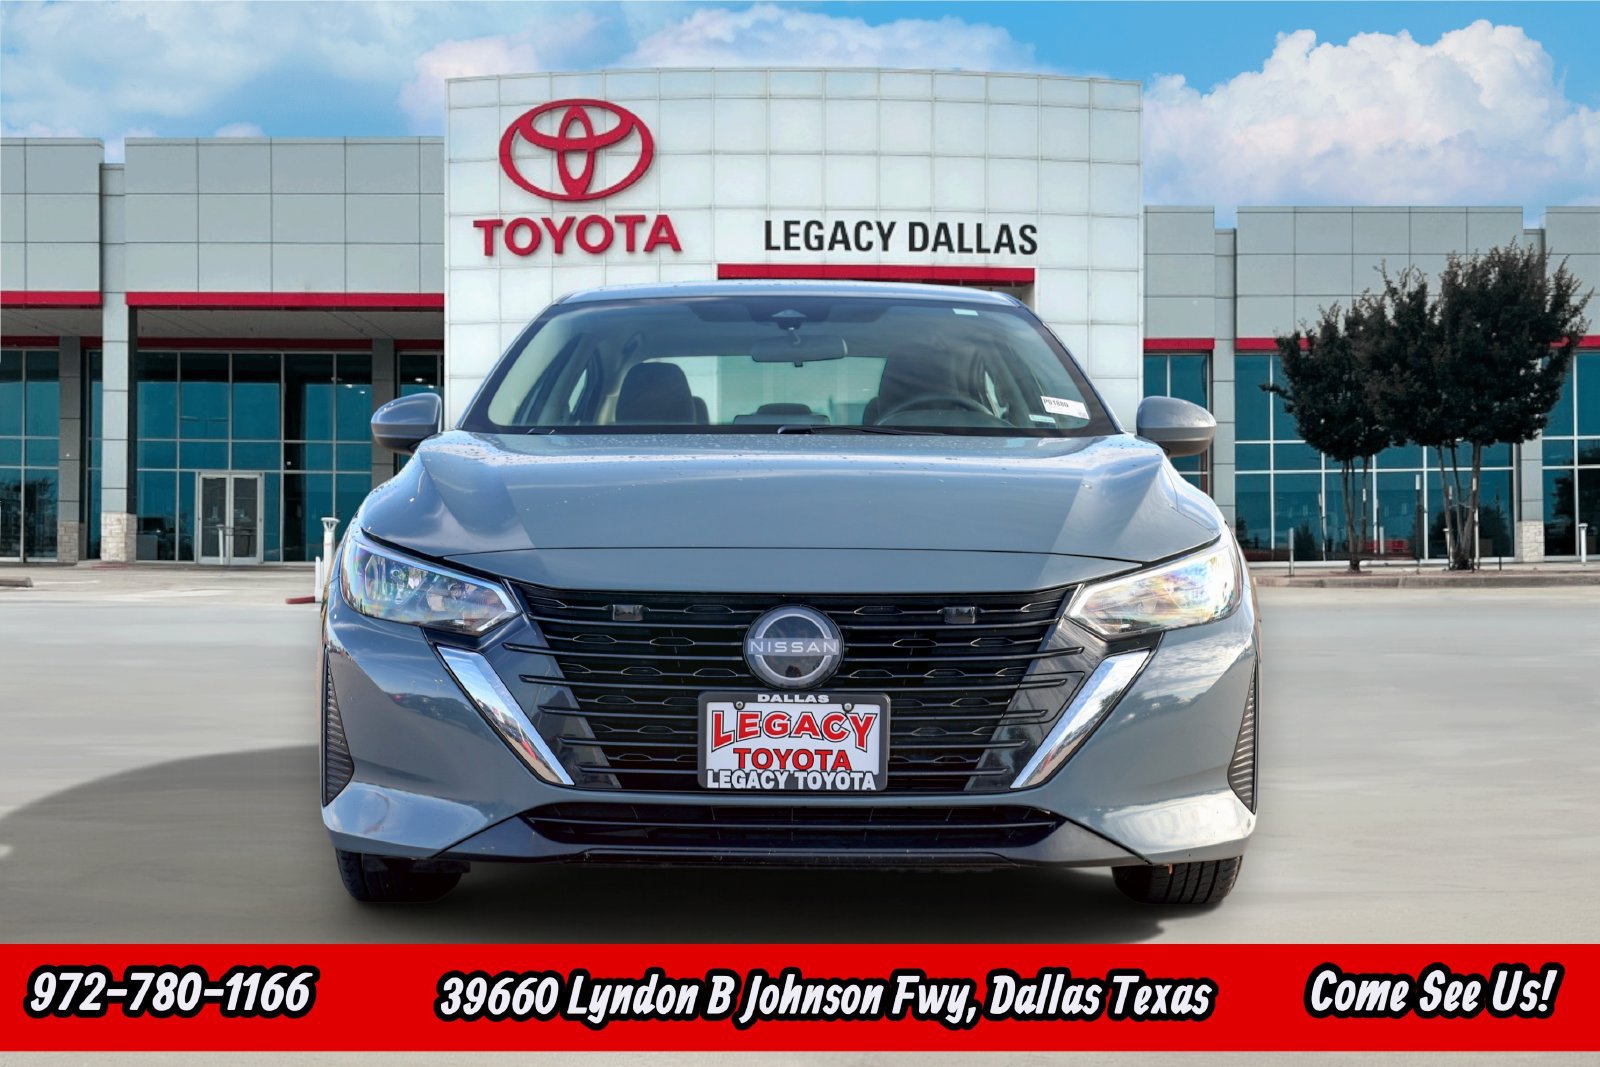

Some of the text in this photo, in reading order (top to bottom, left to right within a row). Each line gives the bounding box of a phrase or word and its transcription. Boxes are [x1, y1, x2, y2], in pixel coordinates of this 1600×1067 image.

[474, 213, 682, 257] TOYOTA
[765, 219, 1039, 256] LEGACY DALLAS
[750, 641, 837, 653] NISSAN
[757, 694, 830, 704] DALLAS
[711, 710, 879, 753] LEGACY
[733, 747, 853, 771] TOYOTA
[706, 769, 877, 791] LEGACY TOYOTA
